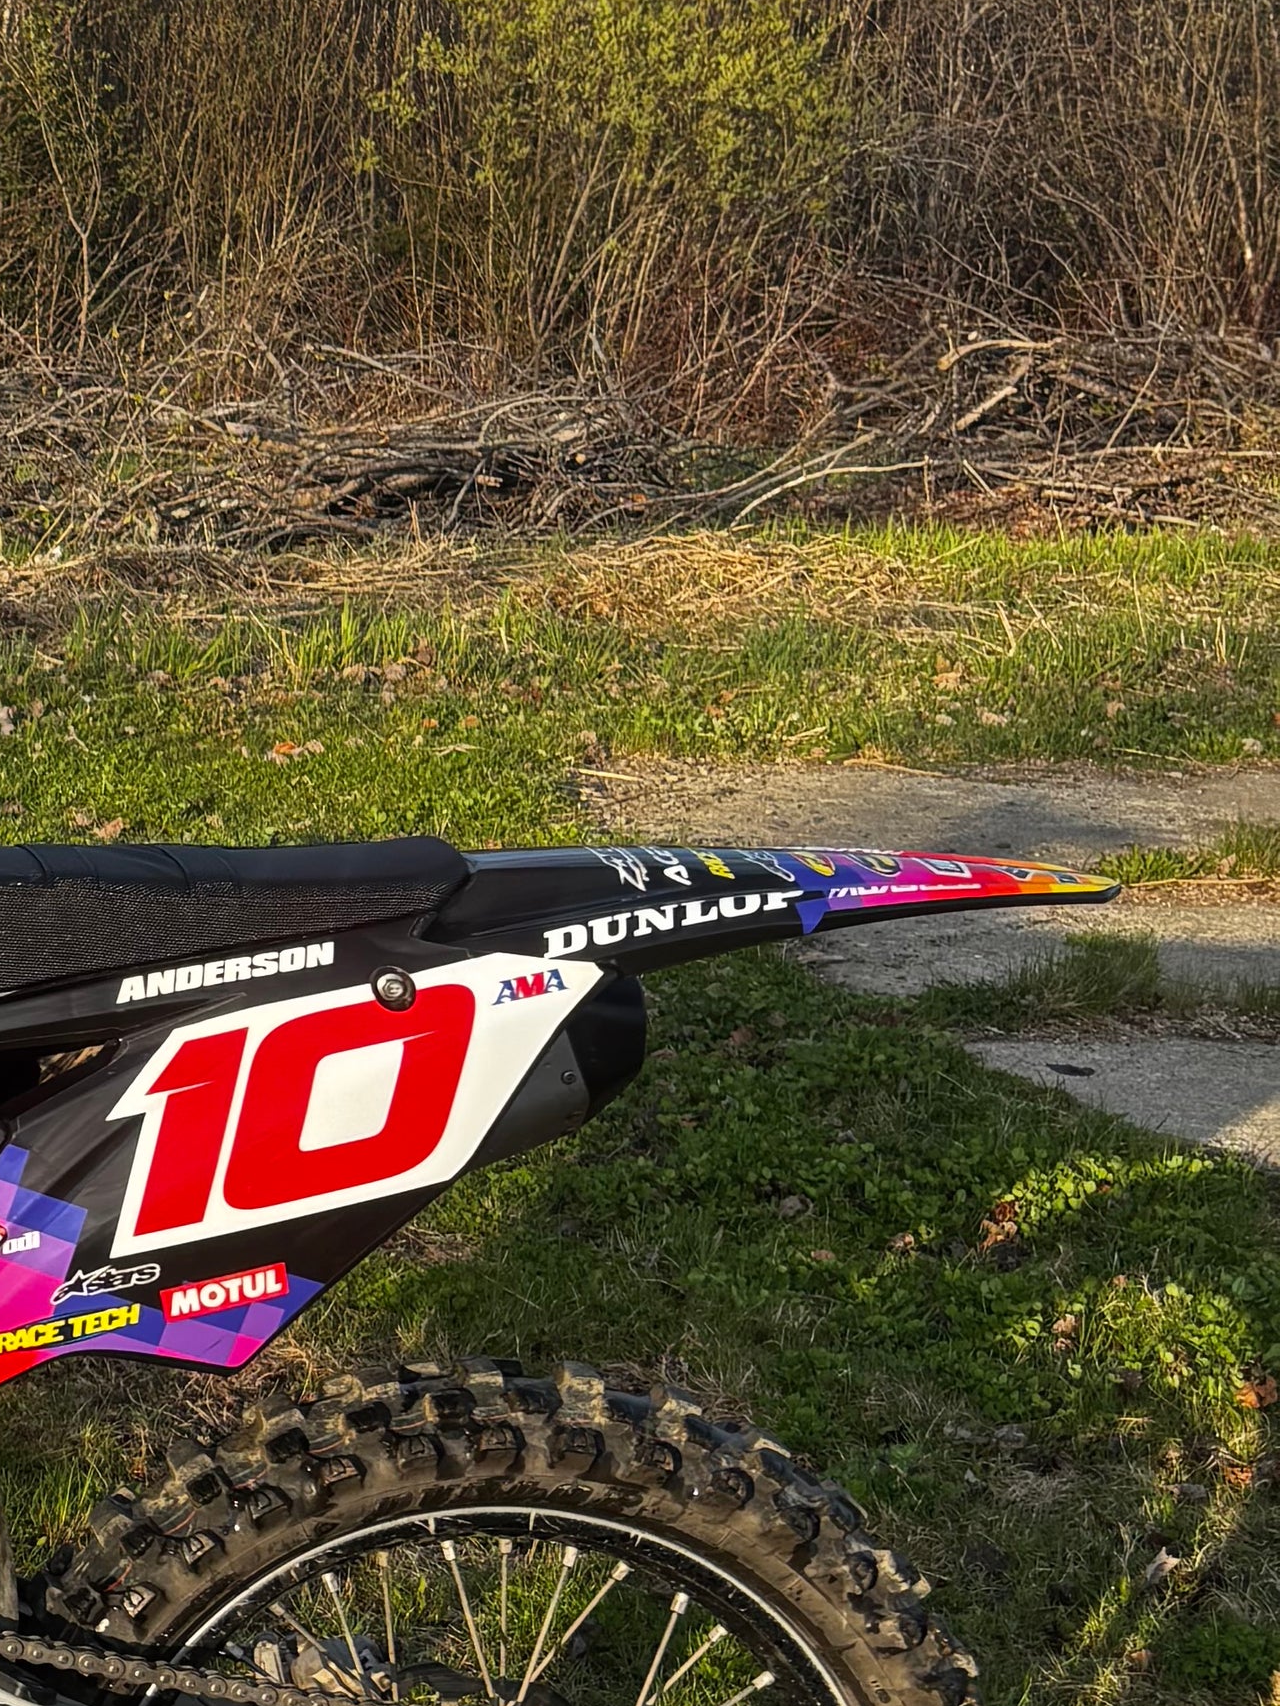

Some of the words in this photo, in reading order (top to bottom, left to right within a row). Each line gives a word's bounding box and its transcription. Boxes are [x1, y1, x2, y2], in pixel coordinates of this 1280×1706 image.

[543, 890, 804, 959] DUNLOP
[116, 942, 335, 1005] ANDERSON
[491, 968, 569, 1006] AMA
[133, 983, 477, 1237] 10
[68, 1303, 141, 1338] TECH
[170, 1268, 284, 1318] MOTUL
